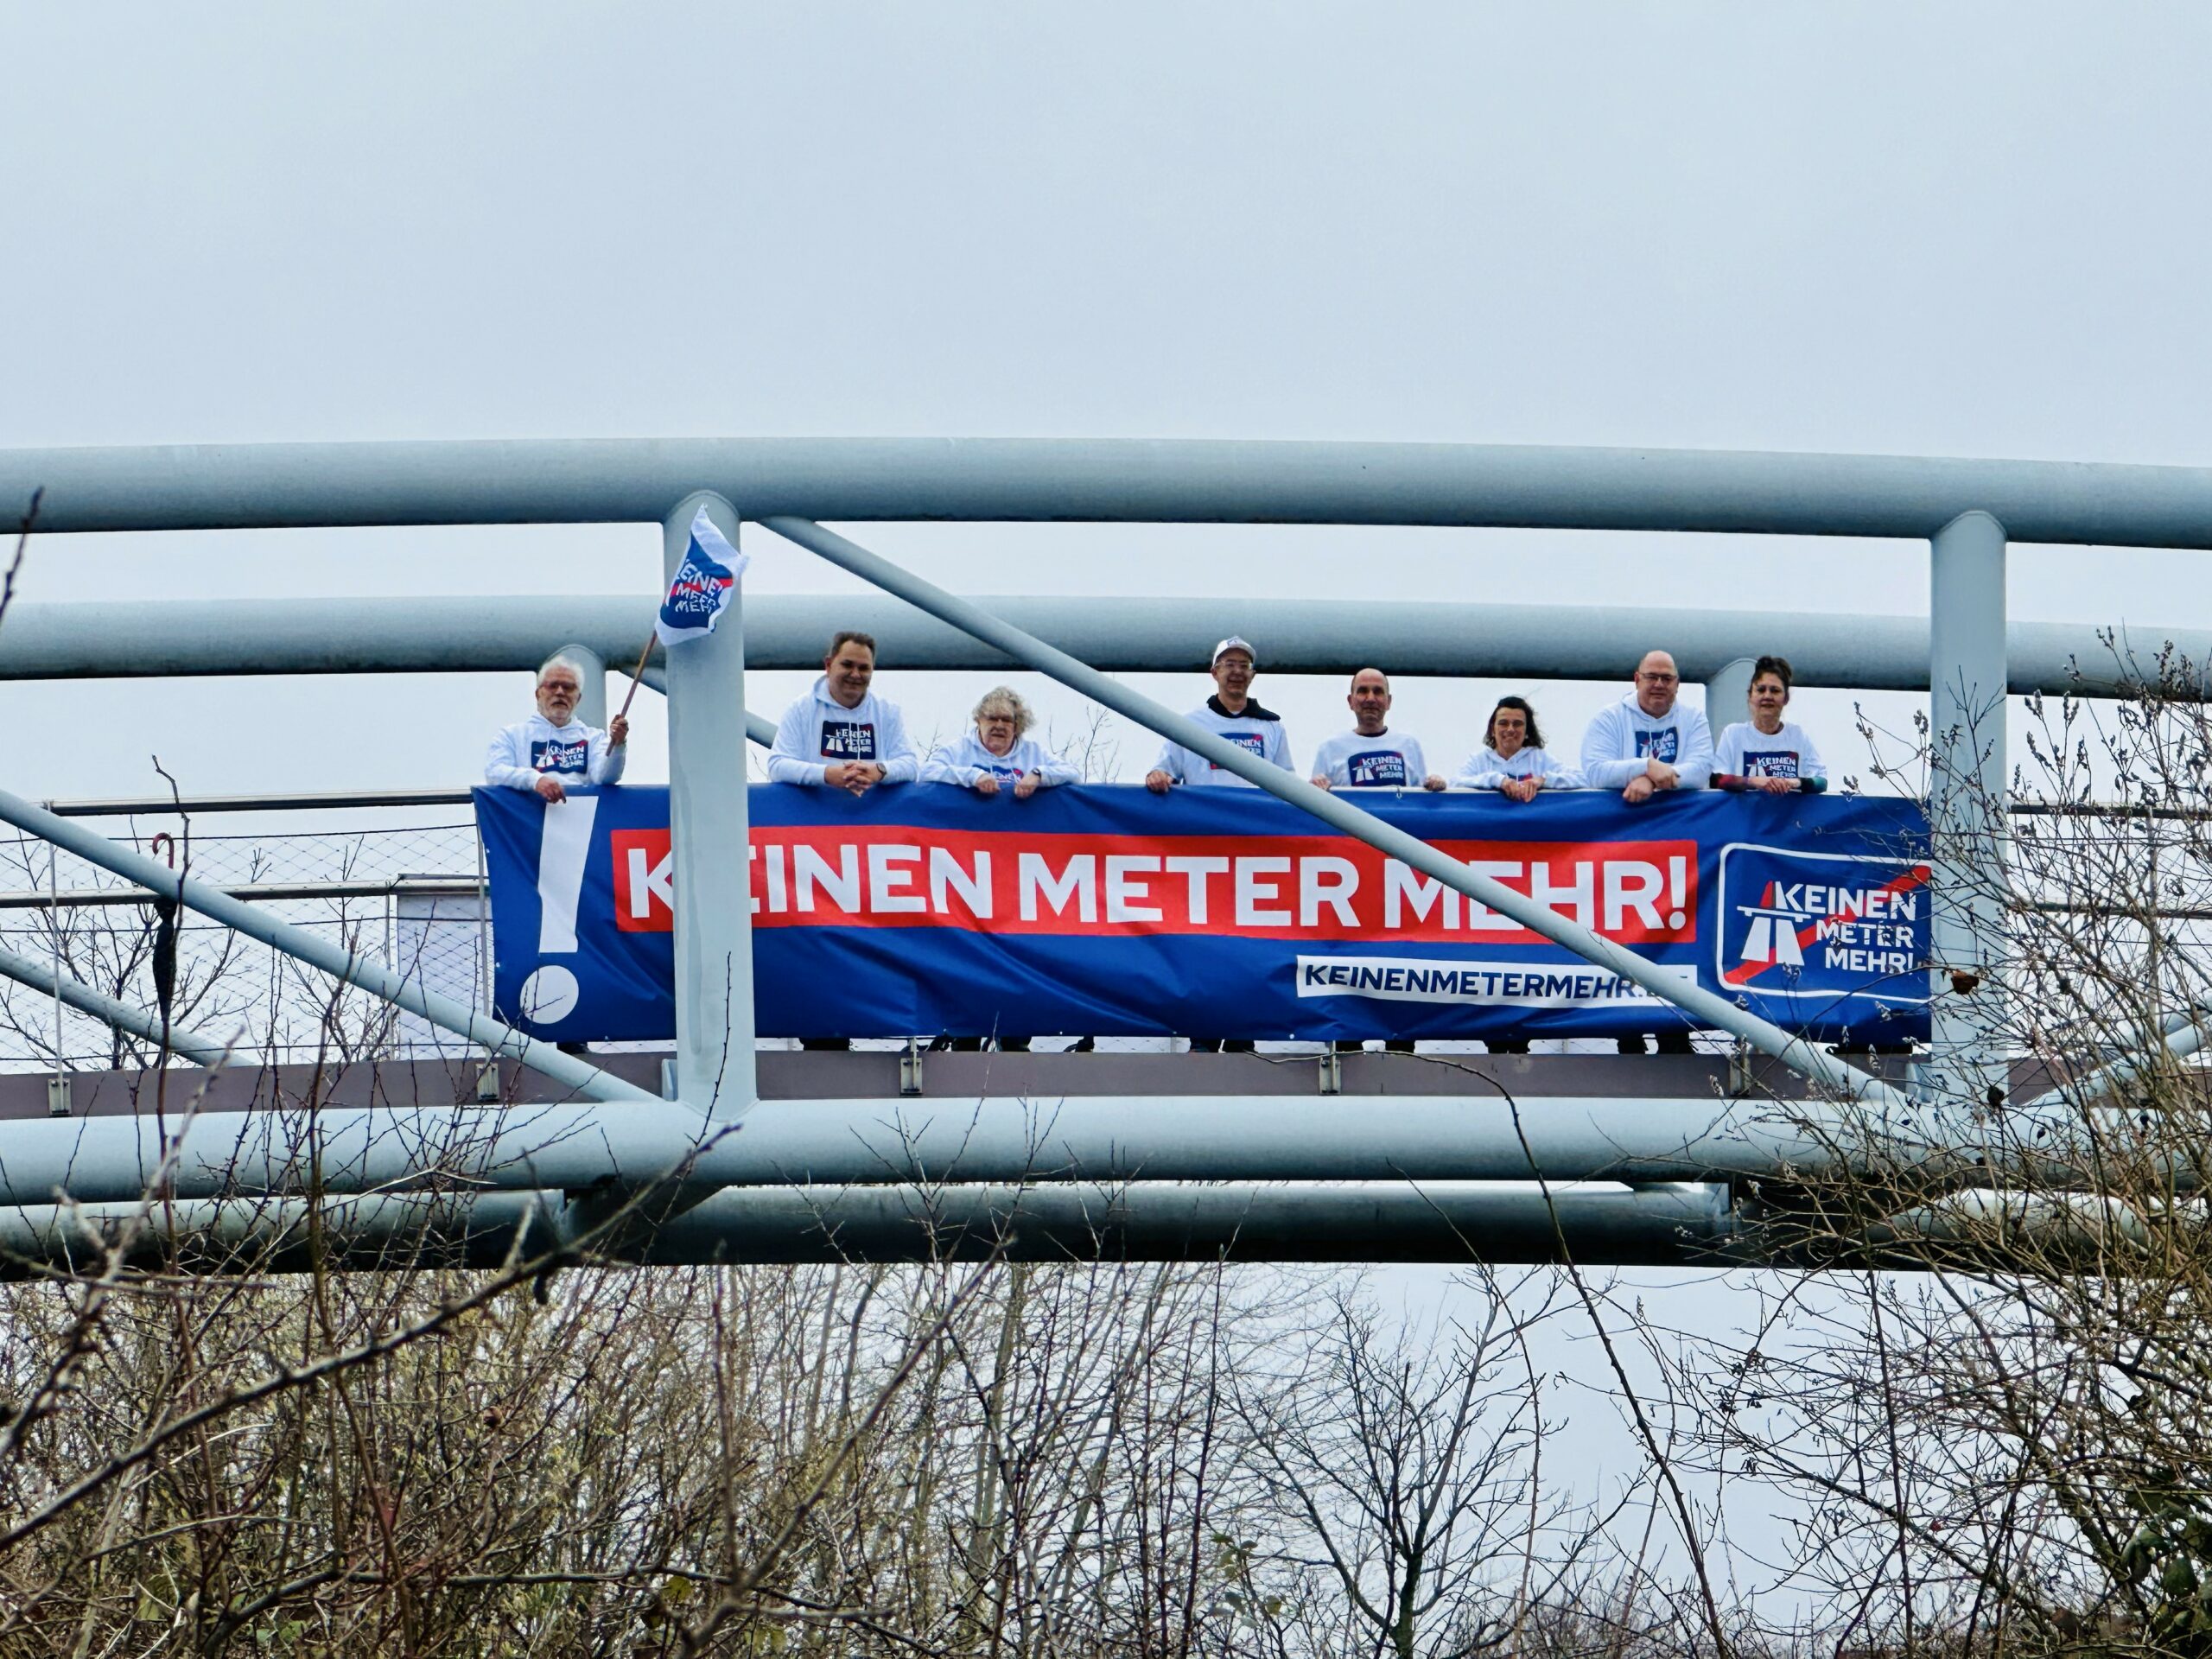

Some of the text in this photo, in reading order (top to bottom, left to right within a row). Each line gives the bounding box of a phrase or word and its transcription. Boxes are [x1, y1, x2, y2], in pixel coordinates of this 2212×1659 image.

[1362, 756, 1402, 768] KEINEN
[1756, 756, 1796, 767] KEINEN
[627, 843, 1687, 931] KINEN METER MEHR!
[1776, 880, 1916, 921] KEINEN
[1816, 919, 1914, 949] METER
[1825, 947, 1914, 976] MEHR!
